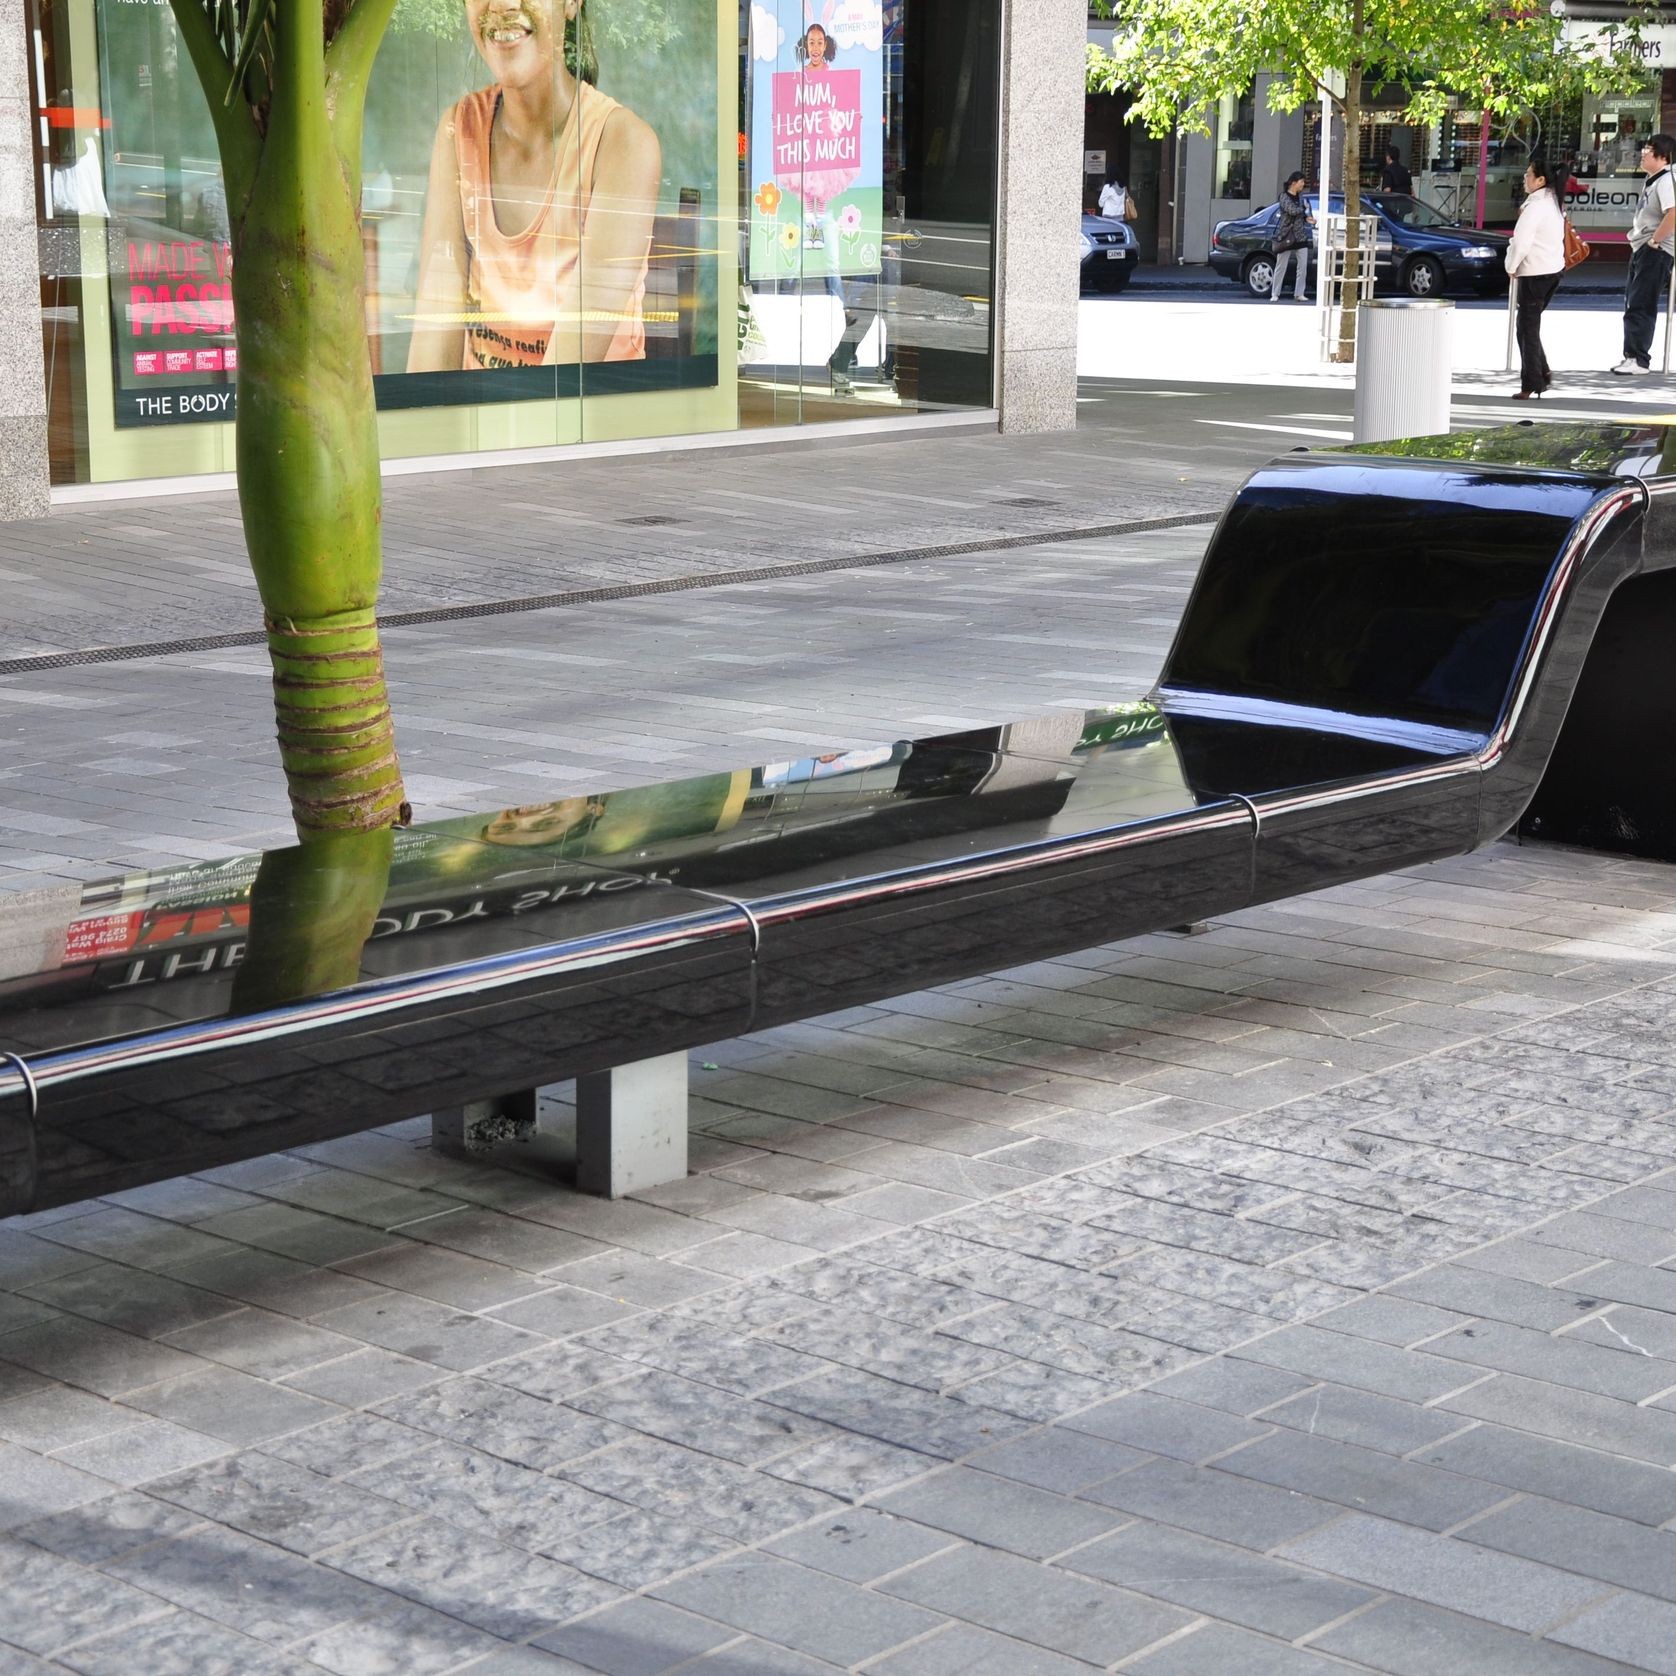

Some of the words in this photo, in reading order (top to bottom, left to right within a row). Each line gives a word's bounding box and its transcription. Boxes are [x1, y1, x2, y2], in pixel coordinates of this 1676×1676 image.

[795, 82, 836, 108] MUM,
[777, 113, 781, 136] I
[786, 110, 824, 136] LOVE
[828, 109, 855, 132] YOU
[777, 138, 811, 165] THIS
[815, 136, 856, 162] MUCH
[1563, 187, 1639, 205] poleon
[128, 241, 208, 281] MADE
[130, 283, 233, 335] PASSI
[516, 340, 548, 355] reafi
[136, 396, 172, 416] THE
[179, 393, 230, 413] BODY
